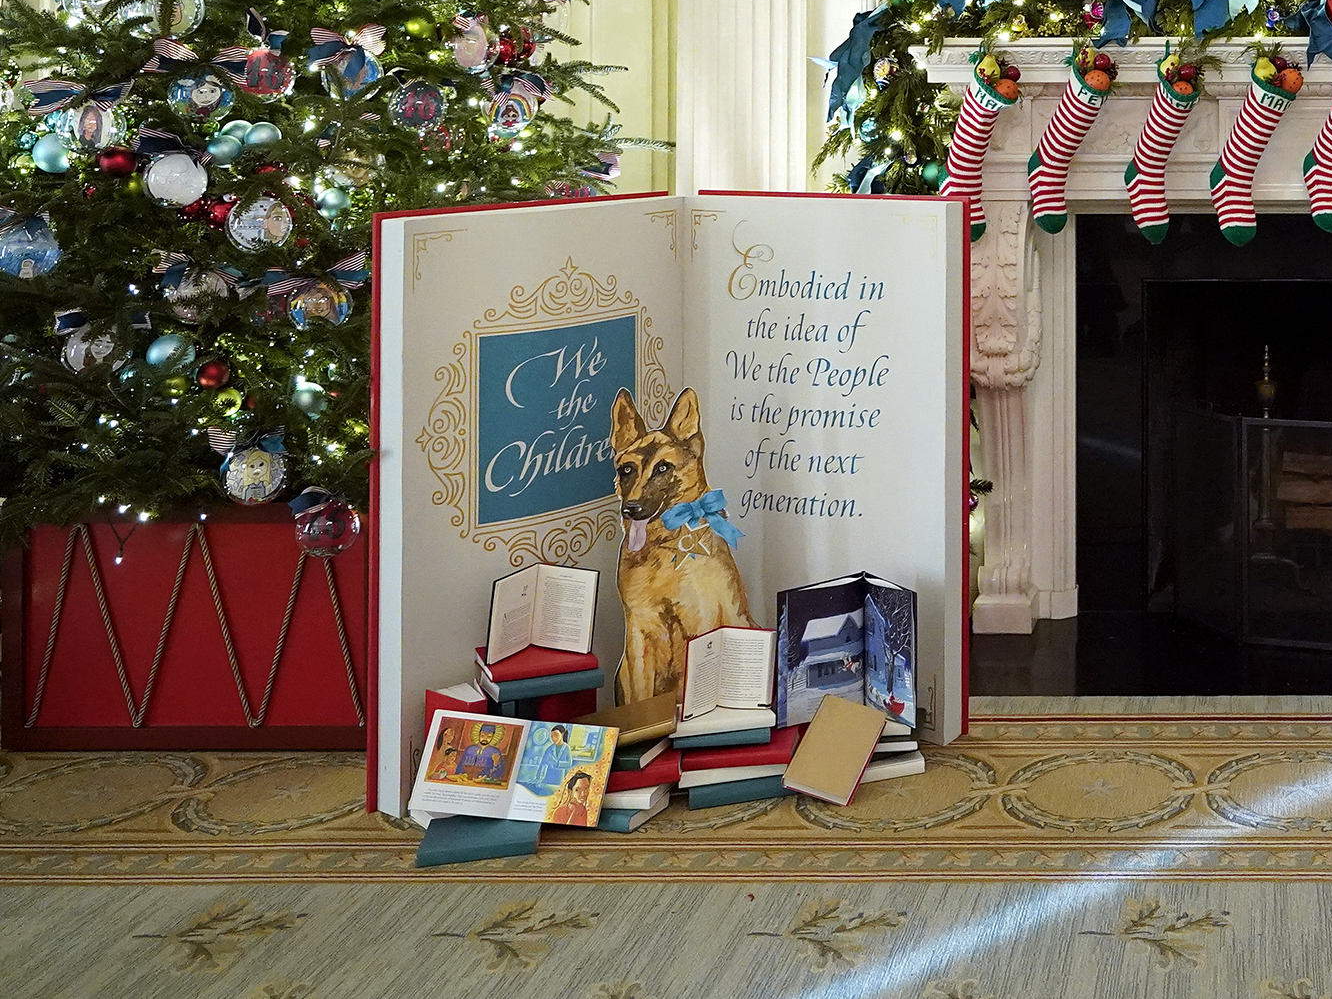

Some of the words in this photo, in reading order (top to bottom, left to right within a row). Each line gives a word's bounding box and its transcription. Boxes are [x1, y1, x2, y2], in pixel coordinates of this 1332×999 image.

[246, 56, 285, 89] 46
[400, 88, 438, 120] 46
[728, 220, 851, 301] Embodied
[860, 276, 885, 301] in
[748, 308, 778, 340] the
[784, 313, 828, 343] idea
[837, 309, 871, 354] of
[506, 337, 608, 409] We
[726, 350, 762, 382] We
[768, 353, 800, 384] the
[806, 355, 890, 397] People
[549, 379, 598, 431] the
[730, 402, 745, 422] is
[751, 393, 782, 425] the
[781, 404, 881, 436] promise
[485, 425, 617, 497] Childre
[744, 438, 770, 479] of
[769, 440, 802, 472] the
[808, 452, 865, 475] next
[739, 489, 863, 519] generation.
[677, 533, 695, 552] C
